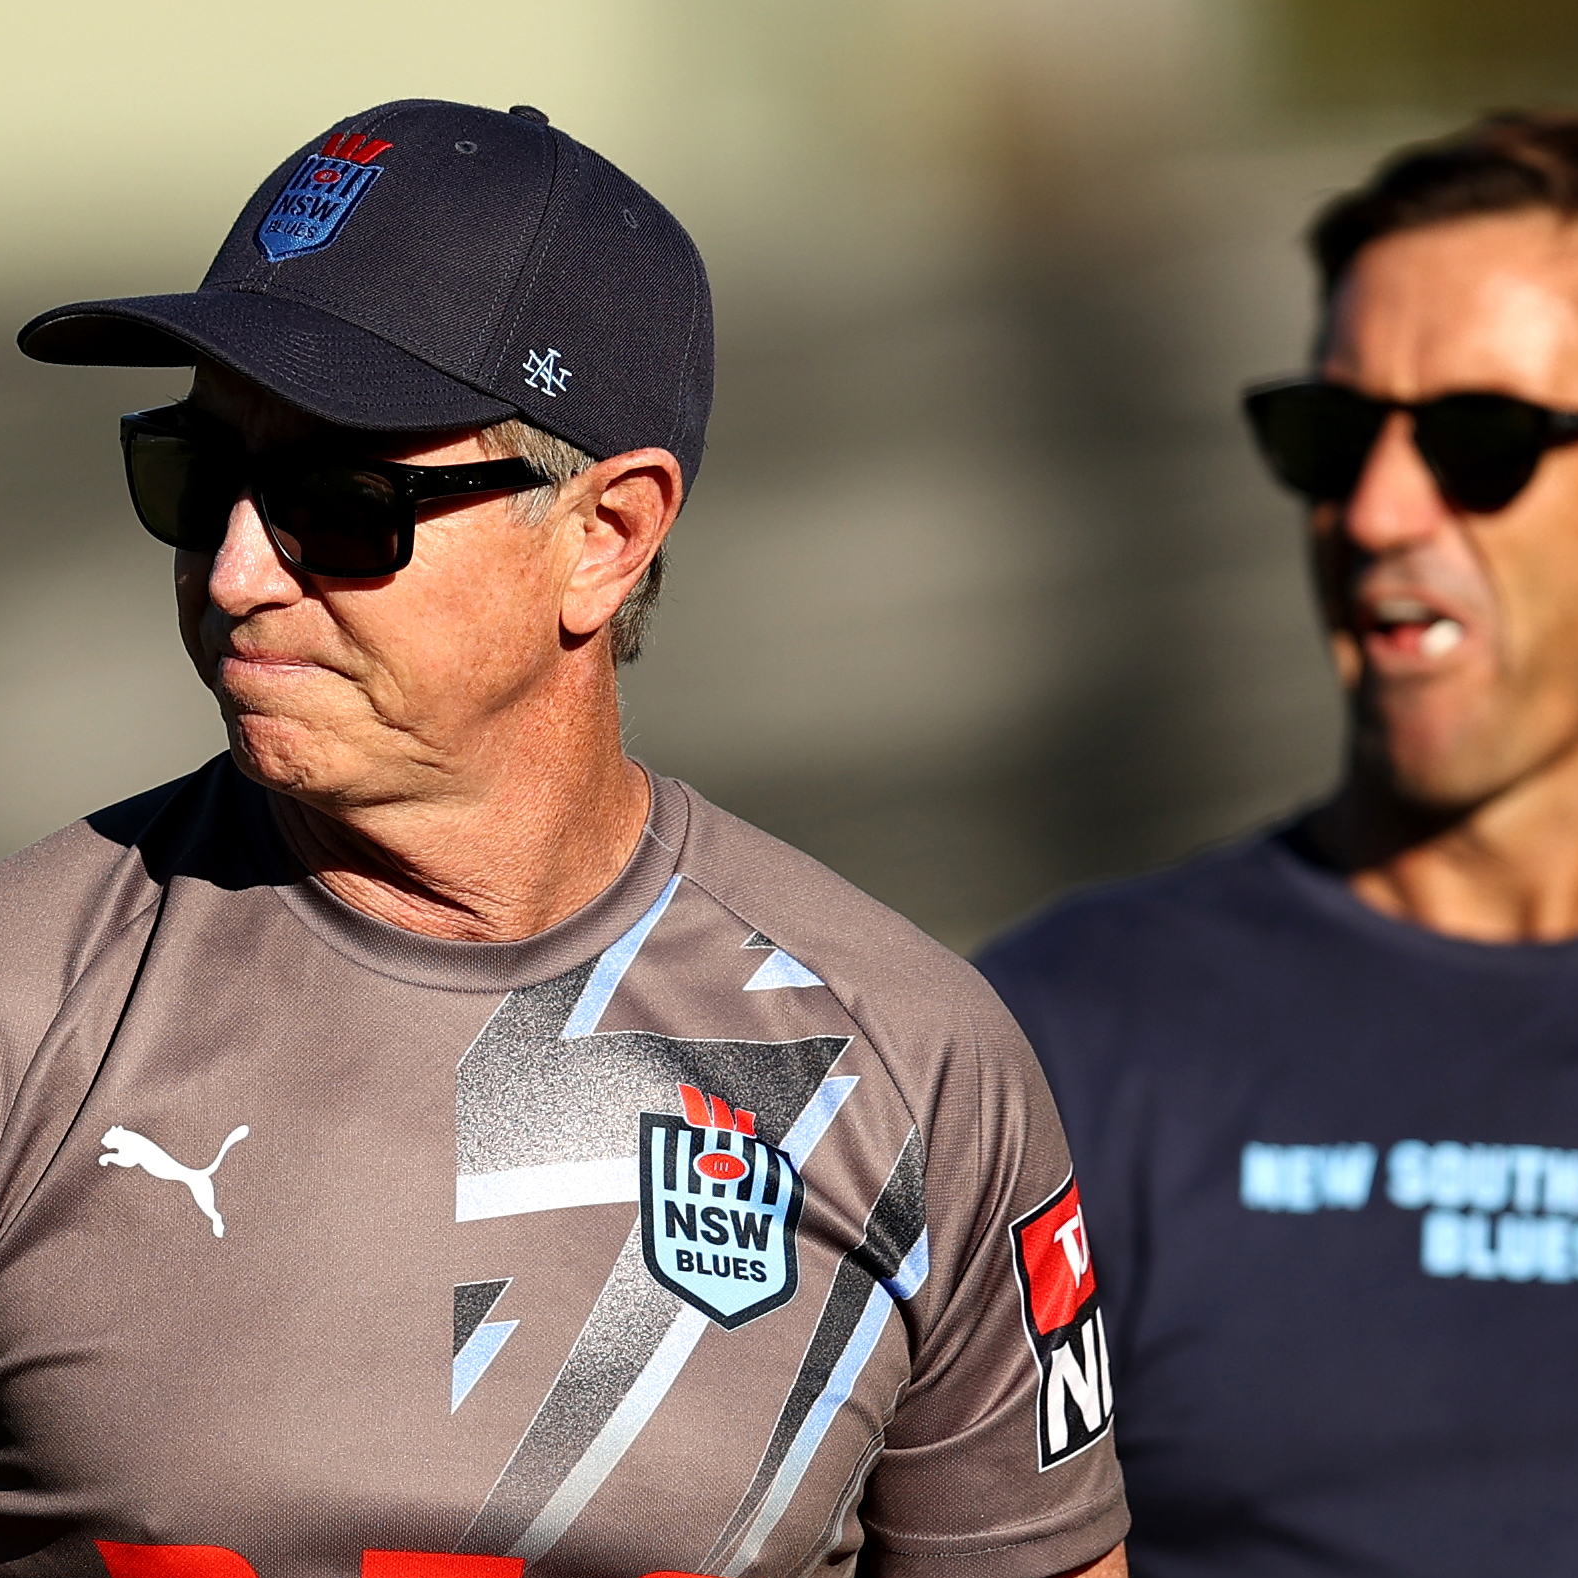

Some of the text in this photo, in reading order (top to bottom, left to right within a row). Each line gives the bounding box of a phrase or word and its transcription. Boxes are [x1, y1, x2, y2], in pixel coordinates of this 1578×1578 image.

[273, 194, 340, 222] NSW
[265, 219, 318, 239] BLUES
[1239, 1141, 1379, 1213] NEW
[664, 1199, 773, 1252] NSW
[676, 1248, 768, 1283] BLUES
